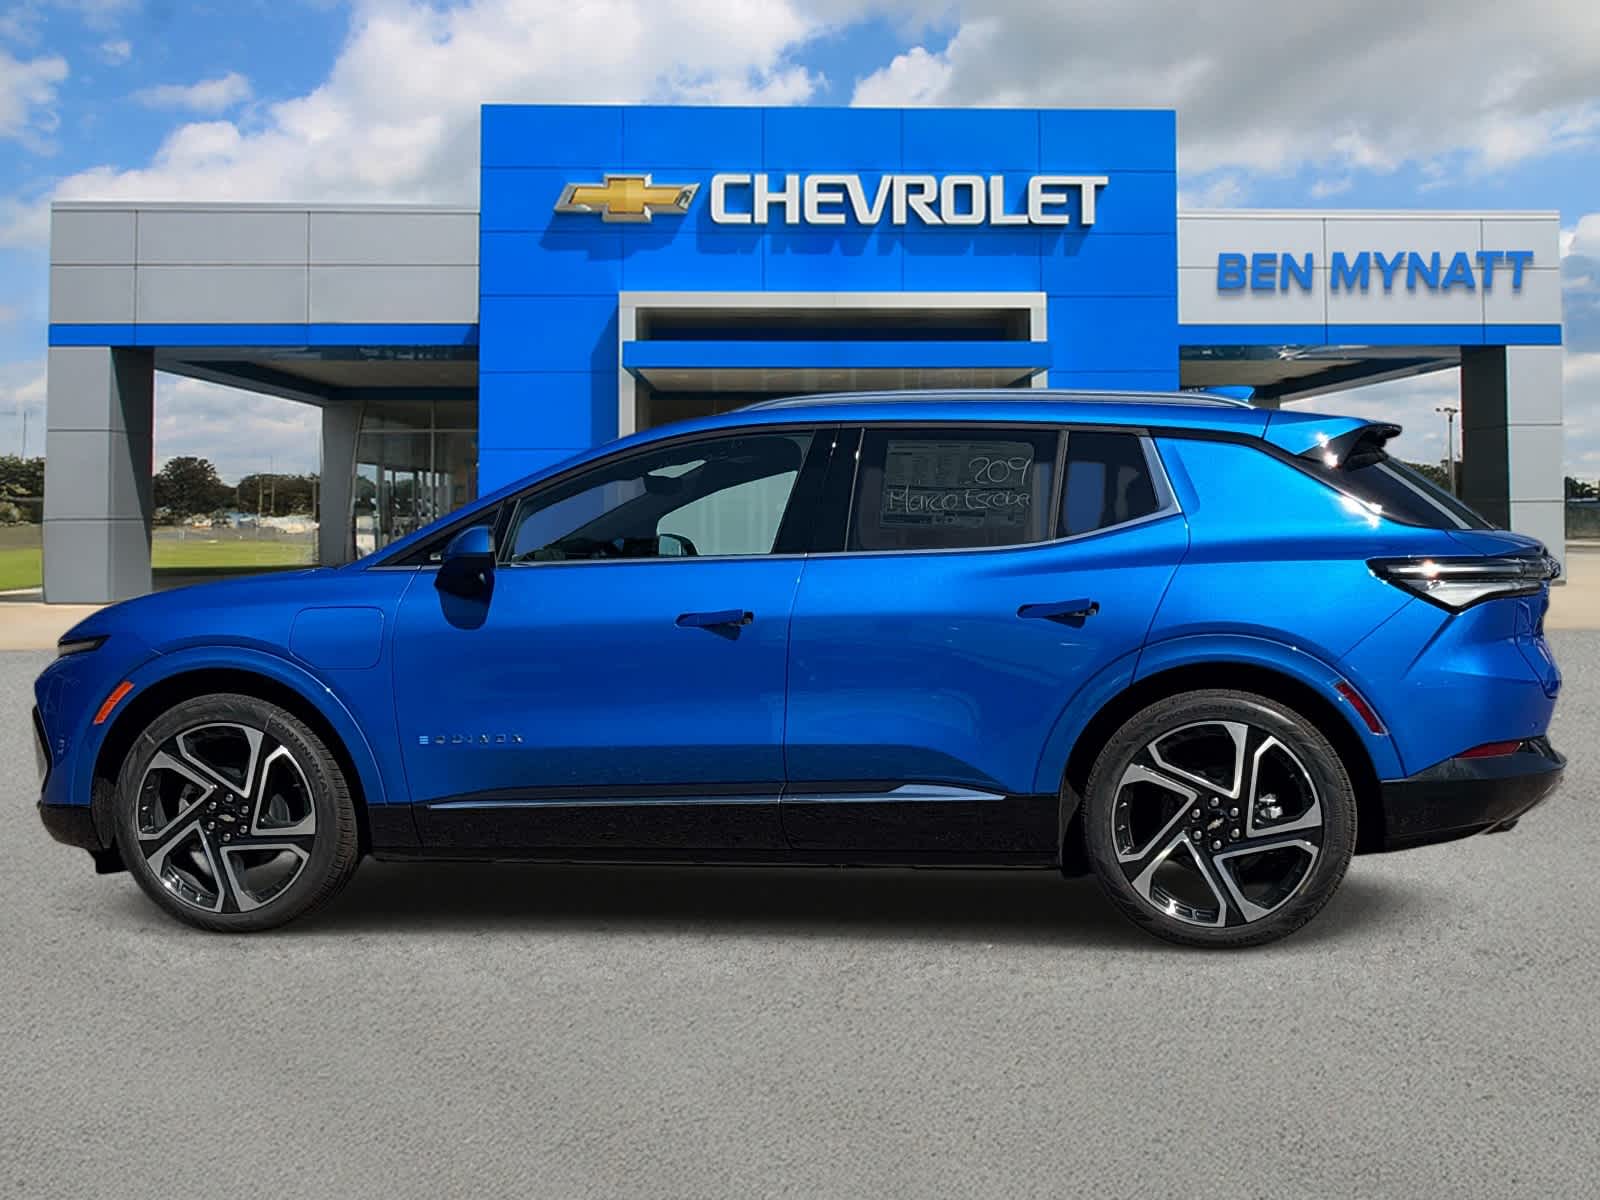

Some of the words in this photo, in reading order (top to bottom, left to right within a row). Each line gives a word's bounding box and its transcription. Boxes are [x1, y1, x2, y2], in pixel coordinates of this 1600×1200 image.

[710, 174, 1109, 225] CHEVROLET
[1216, 251, 1314, 292] BEN
[1330, 250, 1534, 291] MYNATT
[968, 456, 1032, 485] 209
[889, 484, 958, 513] Marco
